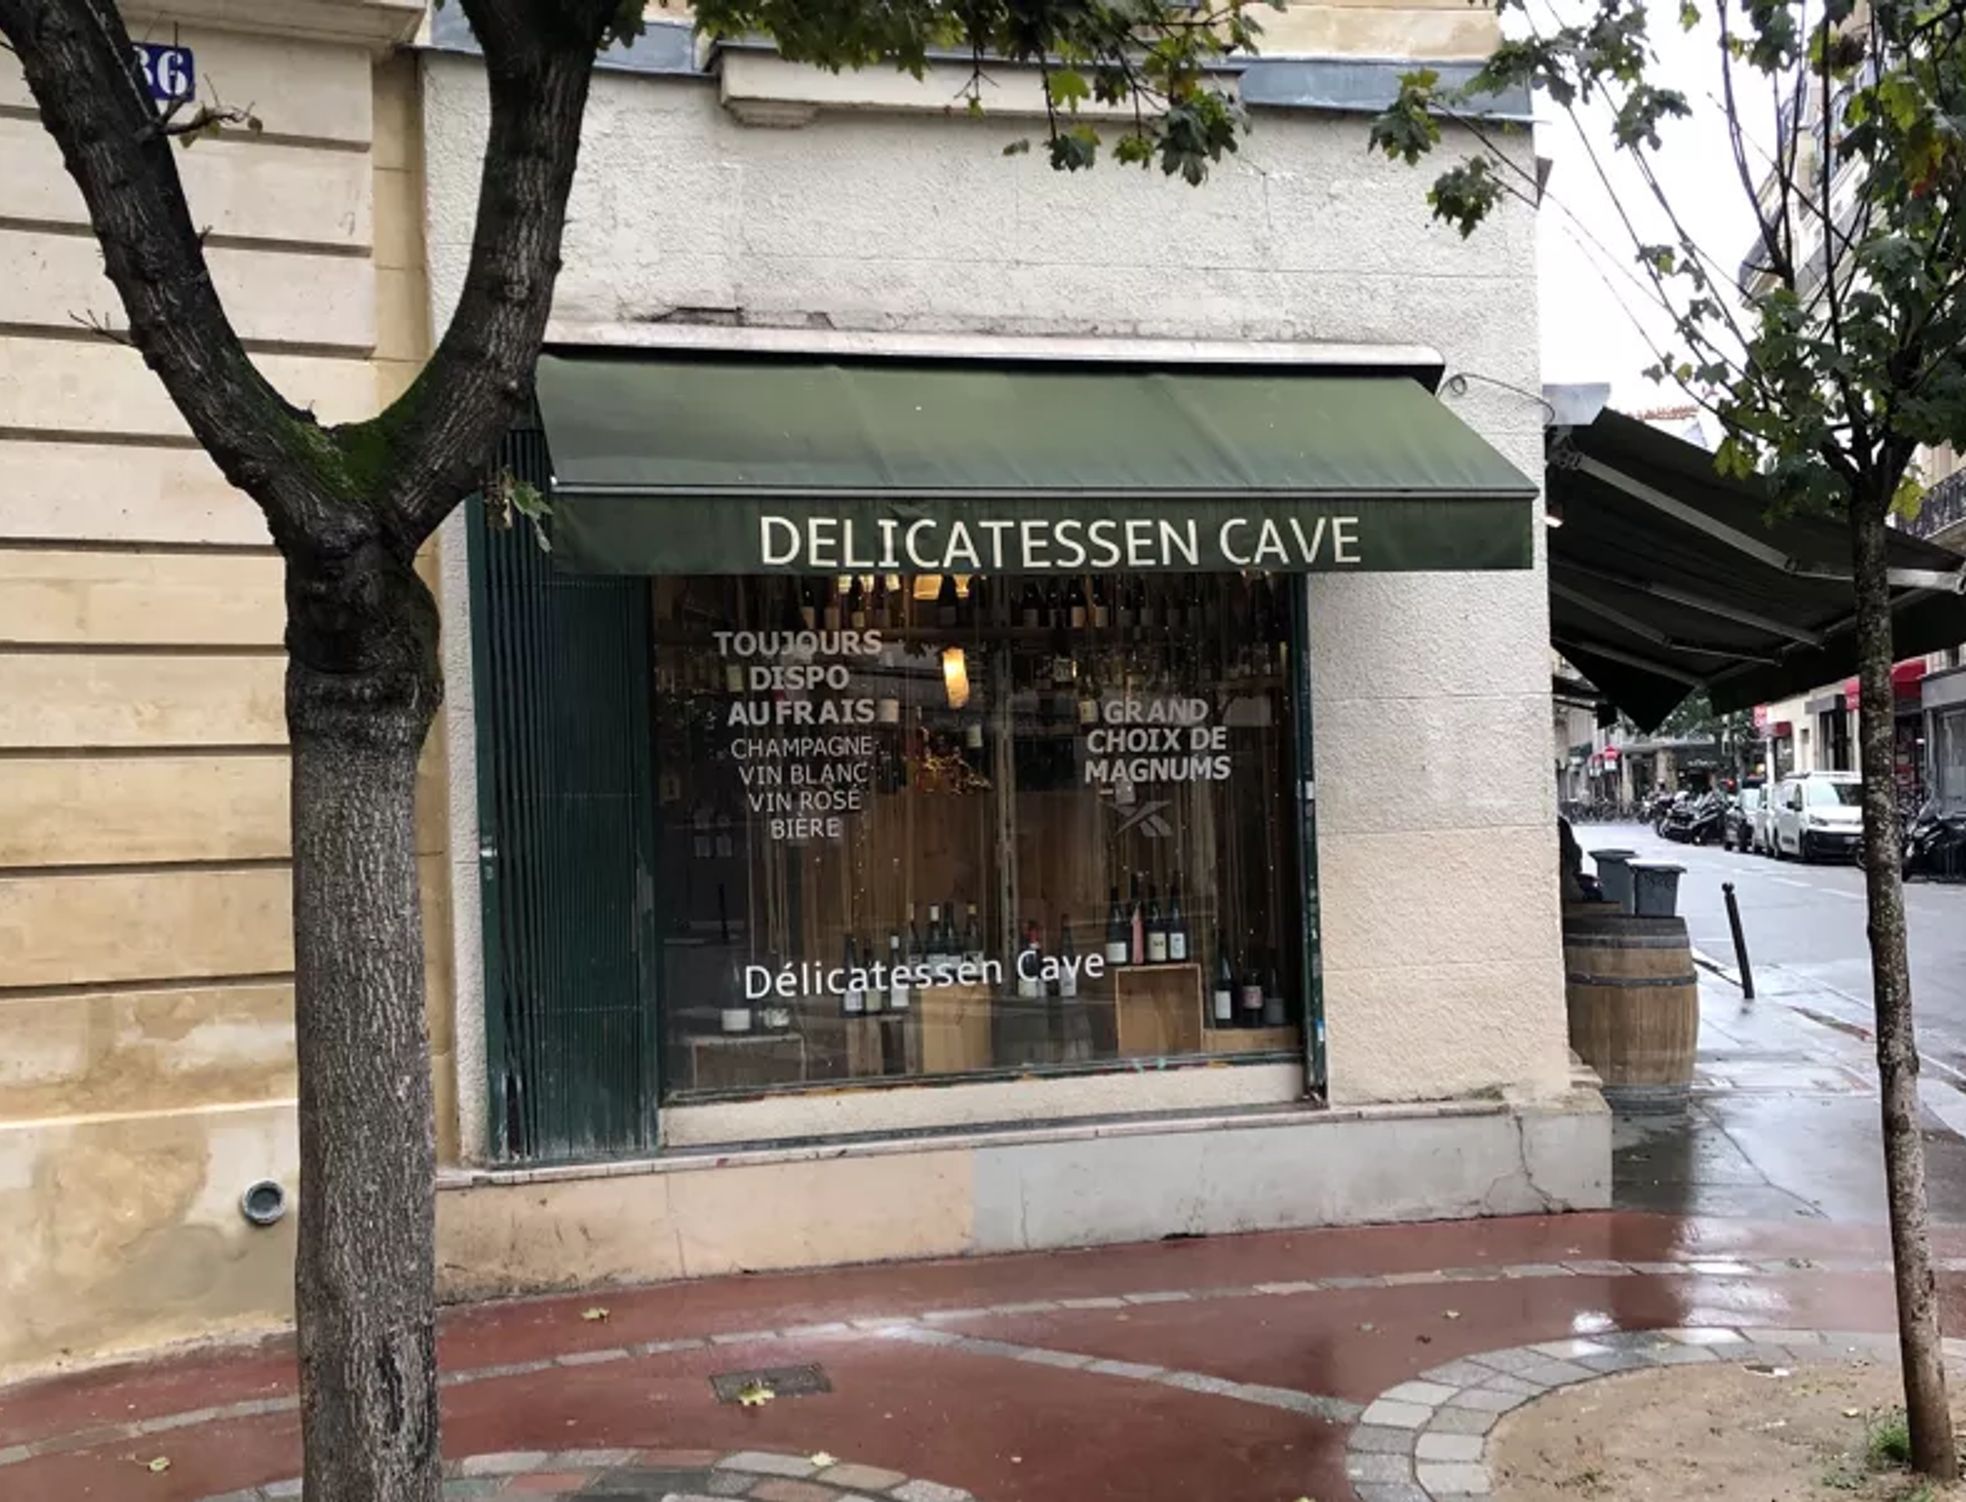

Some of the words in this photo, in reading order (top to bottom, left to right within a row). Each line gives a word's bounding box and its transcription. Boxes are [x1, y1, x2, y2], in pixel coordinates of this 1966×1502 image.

[760, 516, 1199, 569] DELICATESSEN
[1219, 516, 1362, 565] CAVE
[712, 629, 883, 656] TOUJOURS
[751, 665, 849, 690] DISPO
[727, 701, 769, 726] AU
[775, 699, 875, 725] FRAIS
[1104, 699, 1208, 724] GRAND
[731, 736, 873, 759] CHAMPAGNE
[1087, 728, 1182, 753] CHOIX
[1189, 726, 1227, 750] DE
[738, 765, 782, 785] VIN
[791, 763, 868, 784] BLANC
[1085, 755, 1231, 784] MAGNUMS
[749, 792, 791, 812] VIN
[801, 783, 861, 809] ROSÉ
[771, 812, 842, 839] BIÈRE
[745, 958, 1002, 999] Délicatessen
[1017, 950, 1104, 982] Cave
